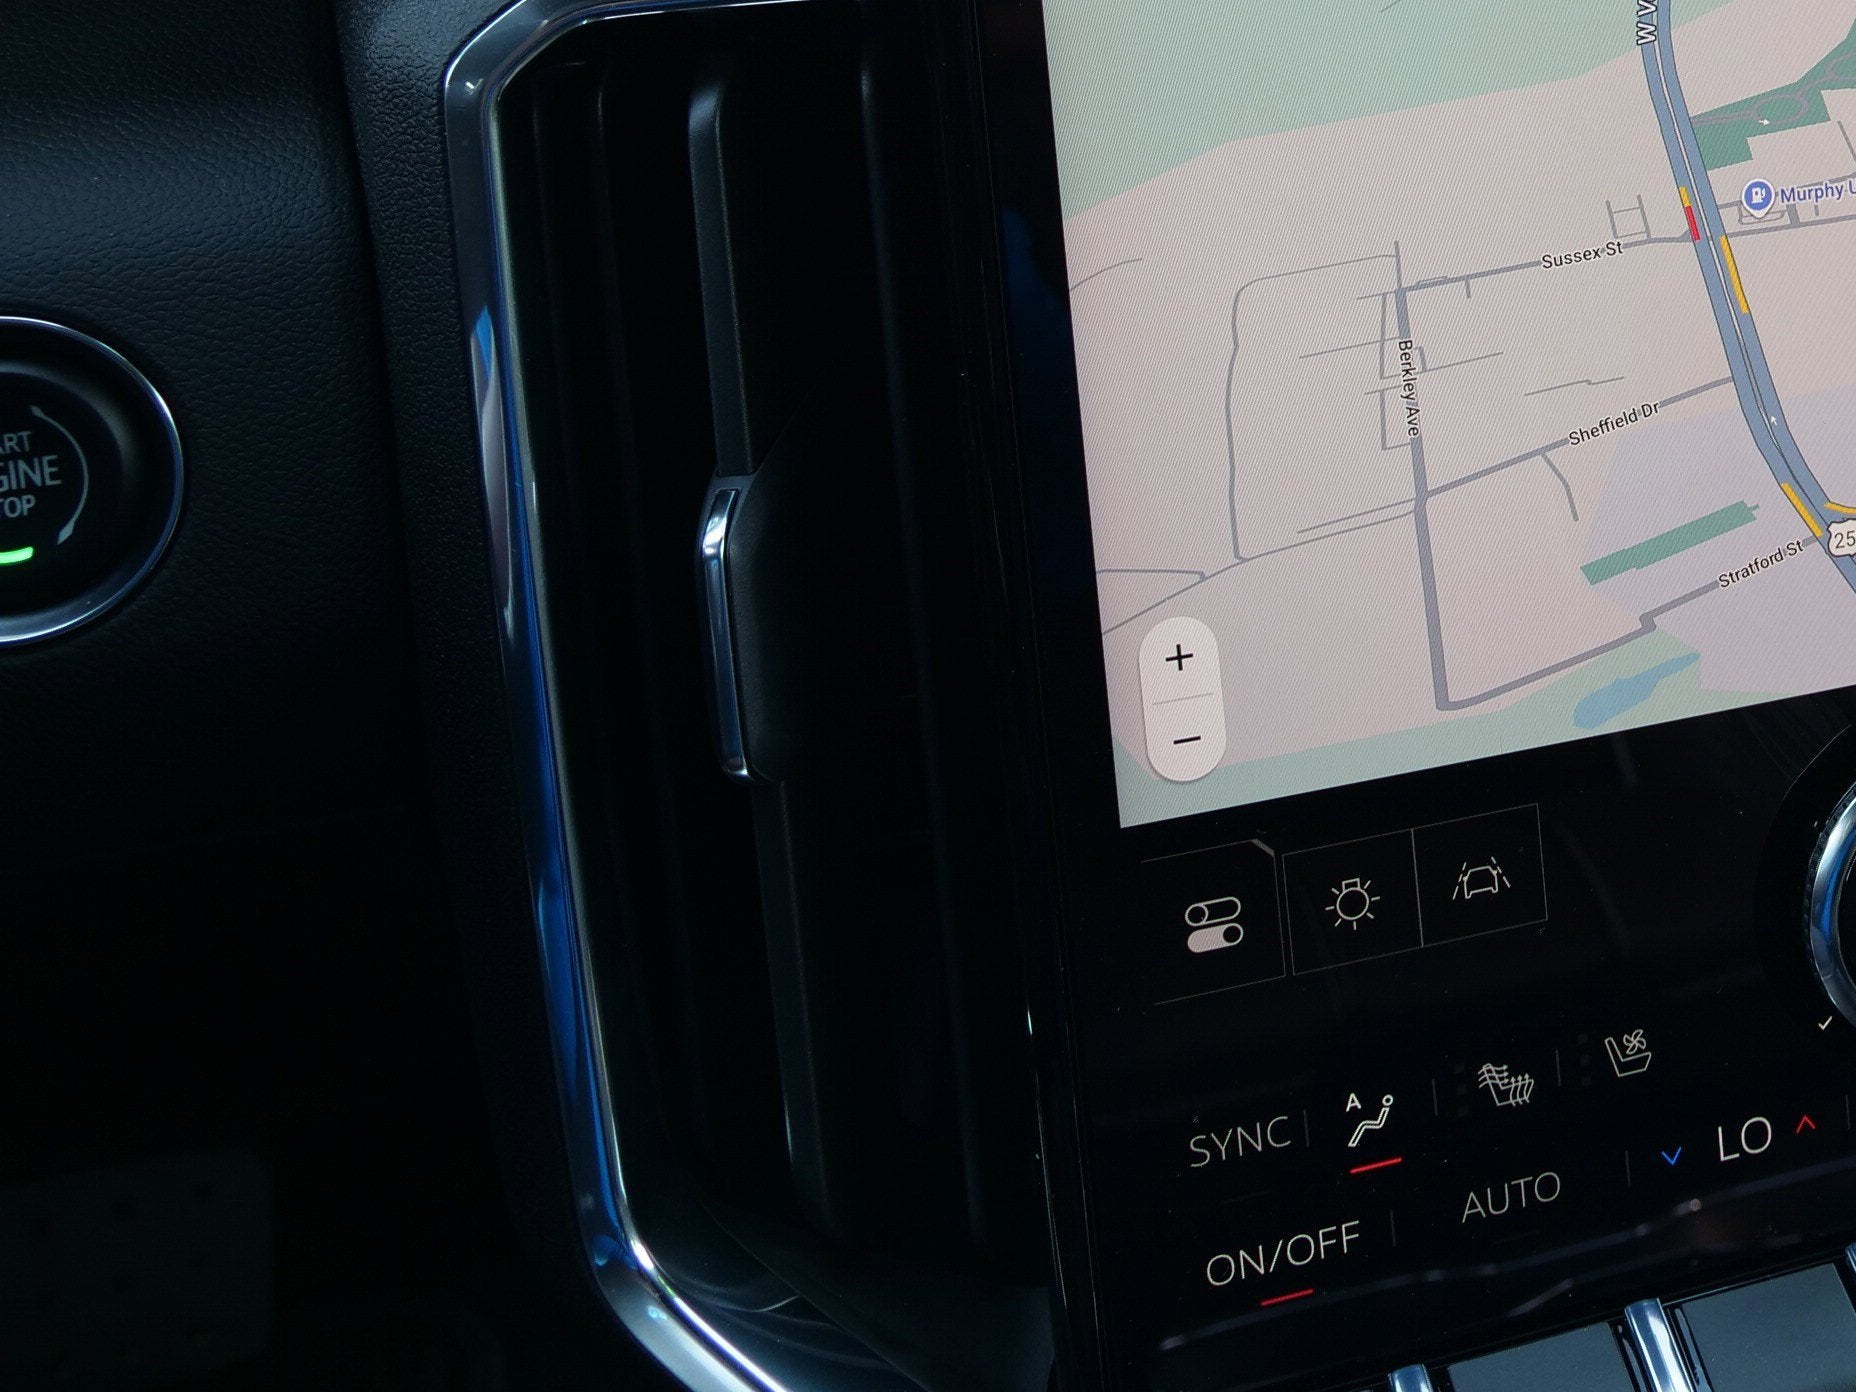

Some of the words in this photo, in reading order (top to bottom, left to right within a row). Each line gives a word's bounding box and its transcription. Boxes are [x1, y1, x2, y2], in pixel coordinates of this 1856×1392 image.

[1637, 24, 1657, 45] W
[1780, 183, 1844, 205] Murphy
[1541, 248, 1602, 270] Sussex
[1604, 241, 1623, 258] St
[1399, 340, 1420, 403] Berkley
[1405, 406, 1420, 437] Ave
[1569, 409, 1639, 447] Sheffield
[1640, 401, 1660, 420] Dr
[1719, 550, 1783, 589] Stratford
[1785, 540, 1804, 561] St
[1190, 1115, 1292, 1168] SYNC
[1717, 1116, 1773, 1162] LO
[1462, 1172, 1562, 1223] AUTO
[1207, 1220, 1360, 1287] ON/OFF
